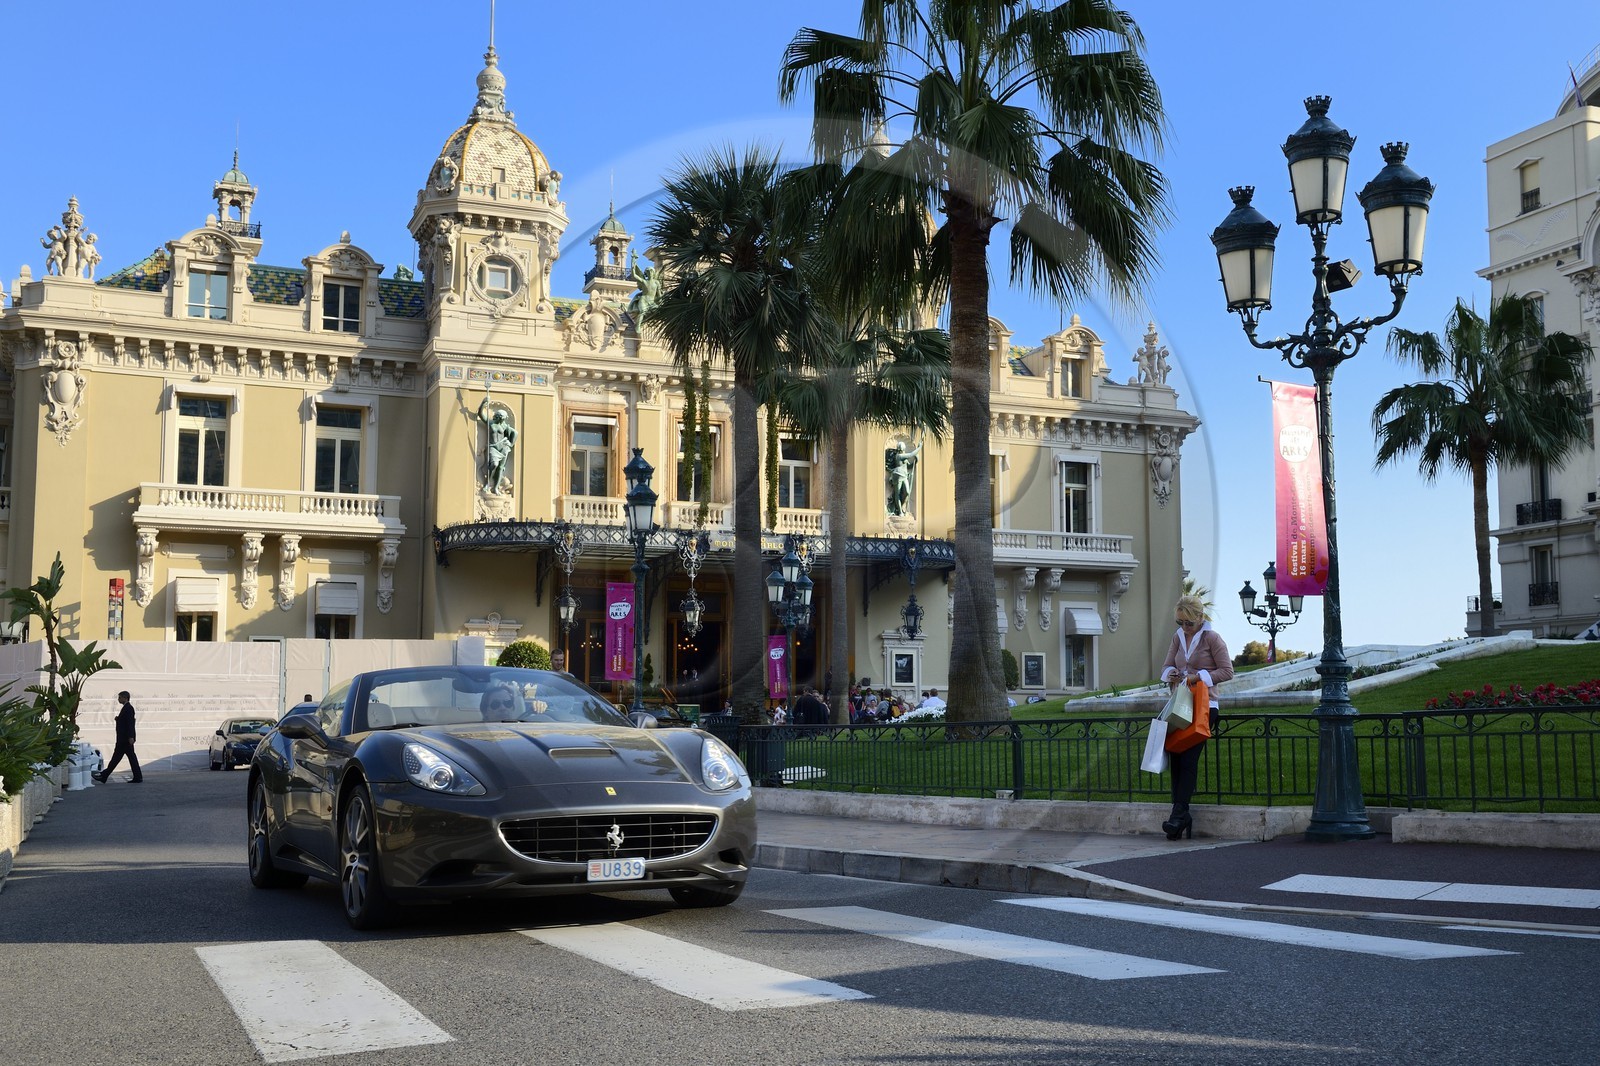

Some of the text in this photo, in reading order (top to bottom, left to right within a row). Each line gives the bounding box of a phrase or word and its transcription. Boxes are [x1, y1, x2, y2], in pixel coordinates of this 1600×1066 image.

[1289, 467, 1298, 526] Monte-Carlo
[1298, 502, 1306, 523] avril
[1290, 528, 1298, 540] de
[1299, 565, 1307, 576] 16
[603, 862, 641, 877] U839
